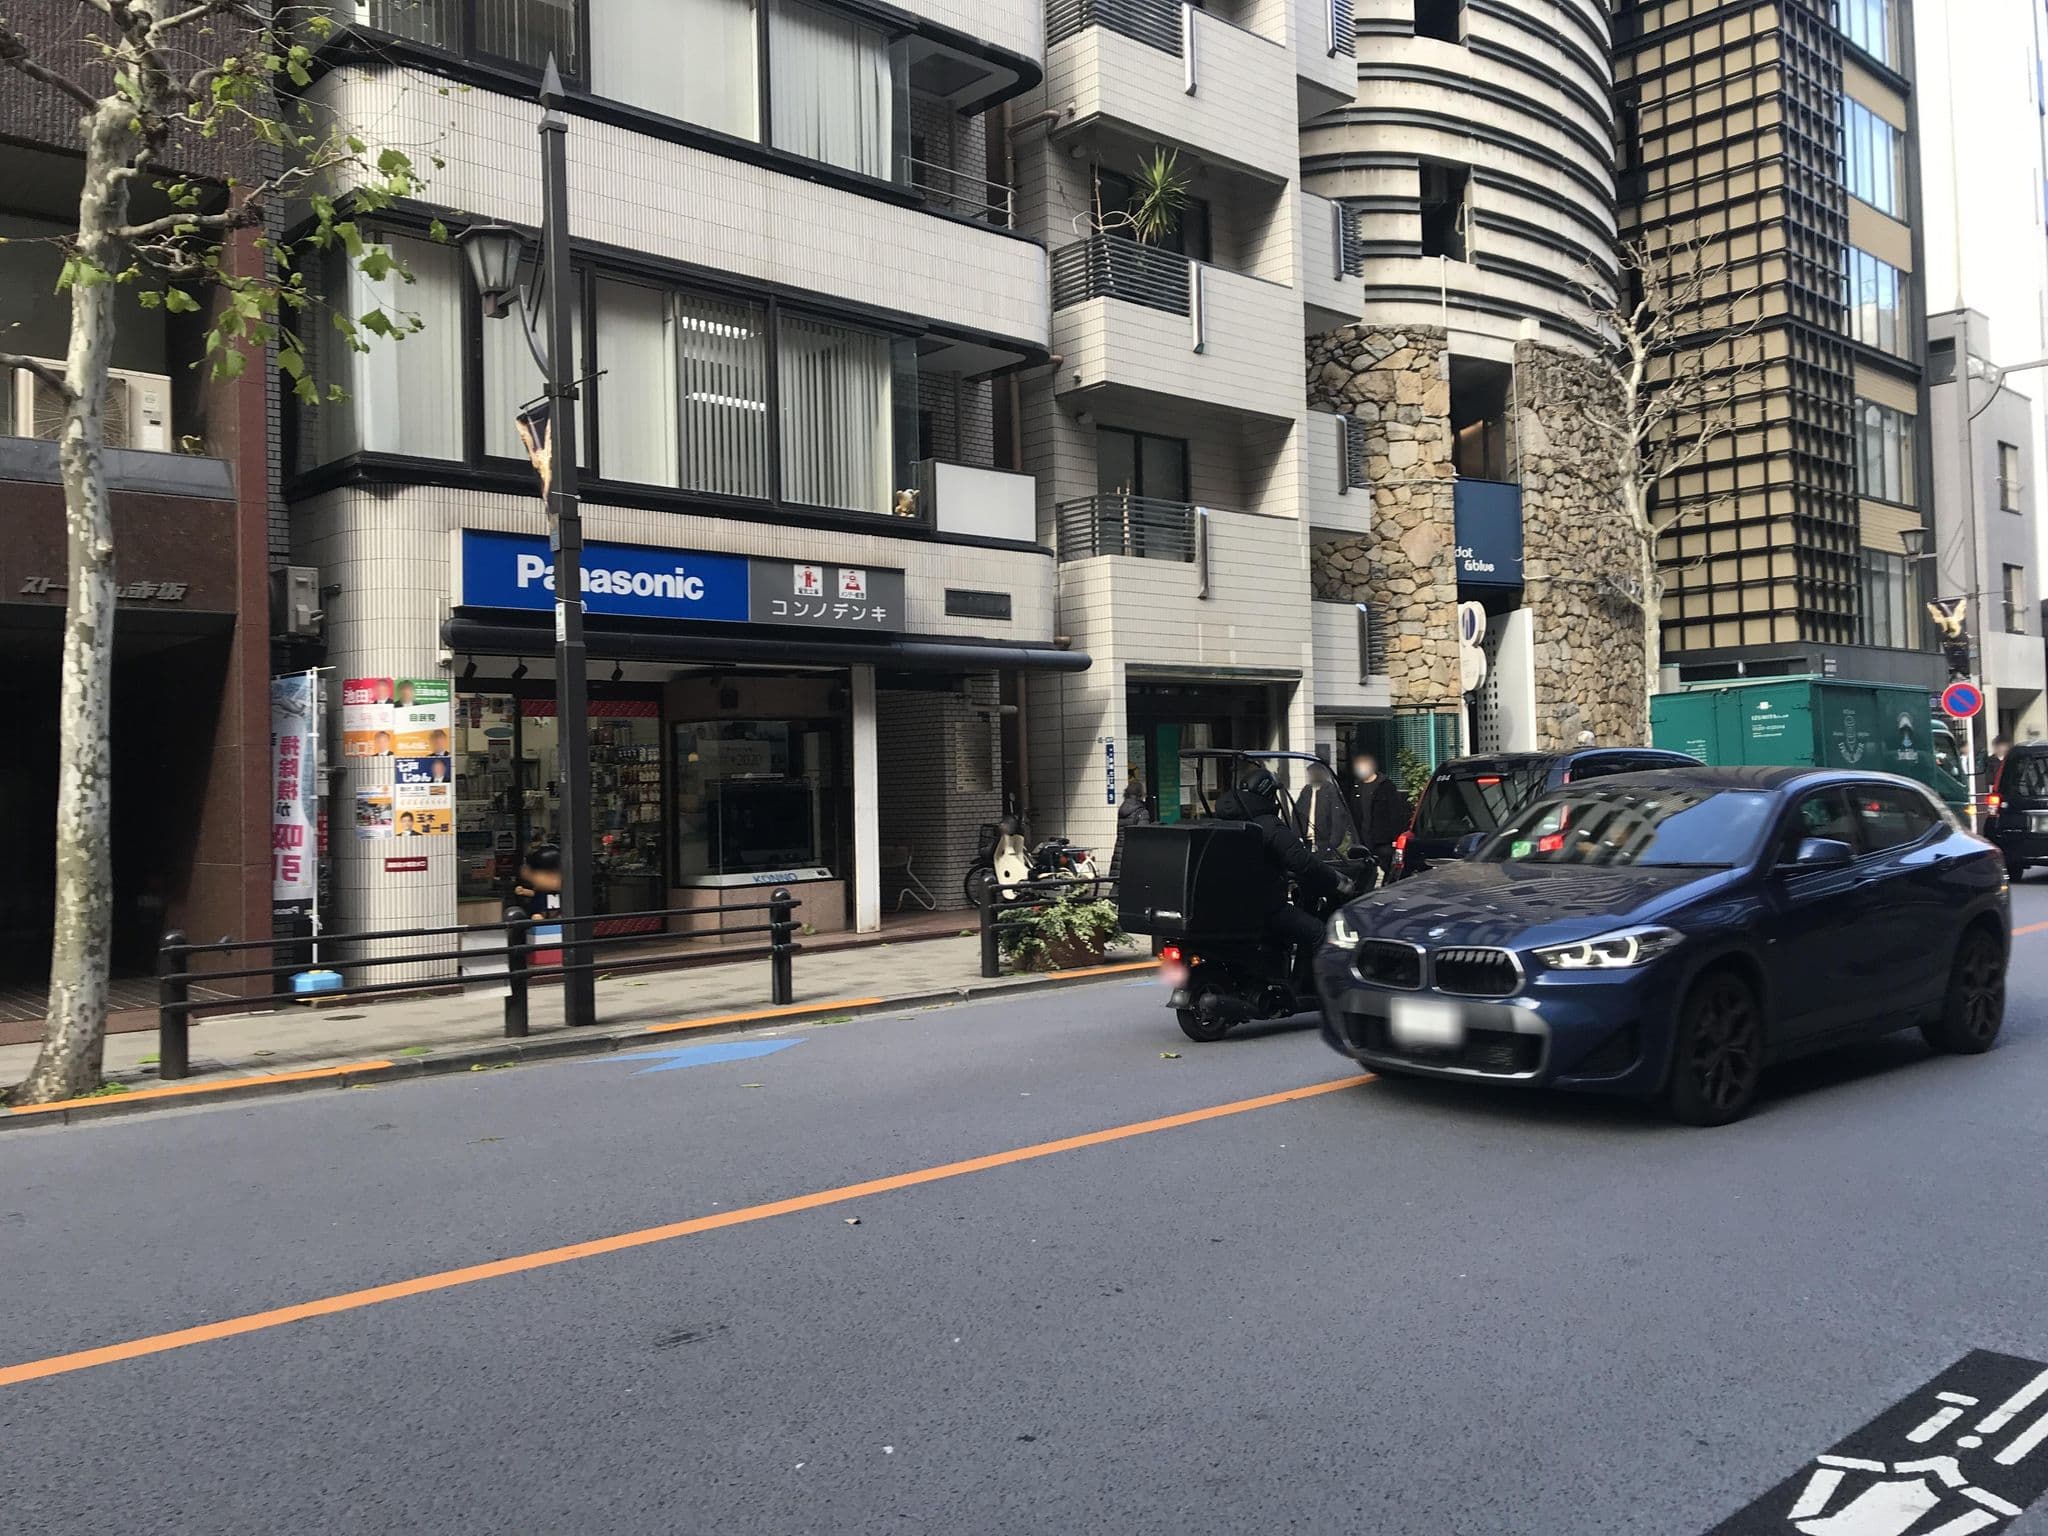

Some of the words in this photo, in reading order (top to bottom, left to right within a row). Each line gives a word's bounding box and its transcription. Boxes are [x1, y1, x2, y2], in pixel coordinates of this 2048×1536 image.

[1455, 547, 1473, 558] dot
[772, 600, 887, 623] コンノデンキ
